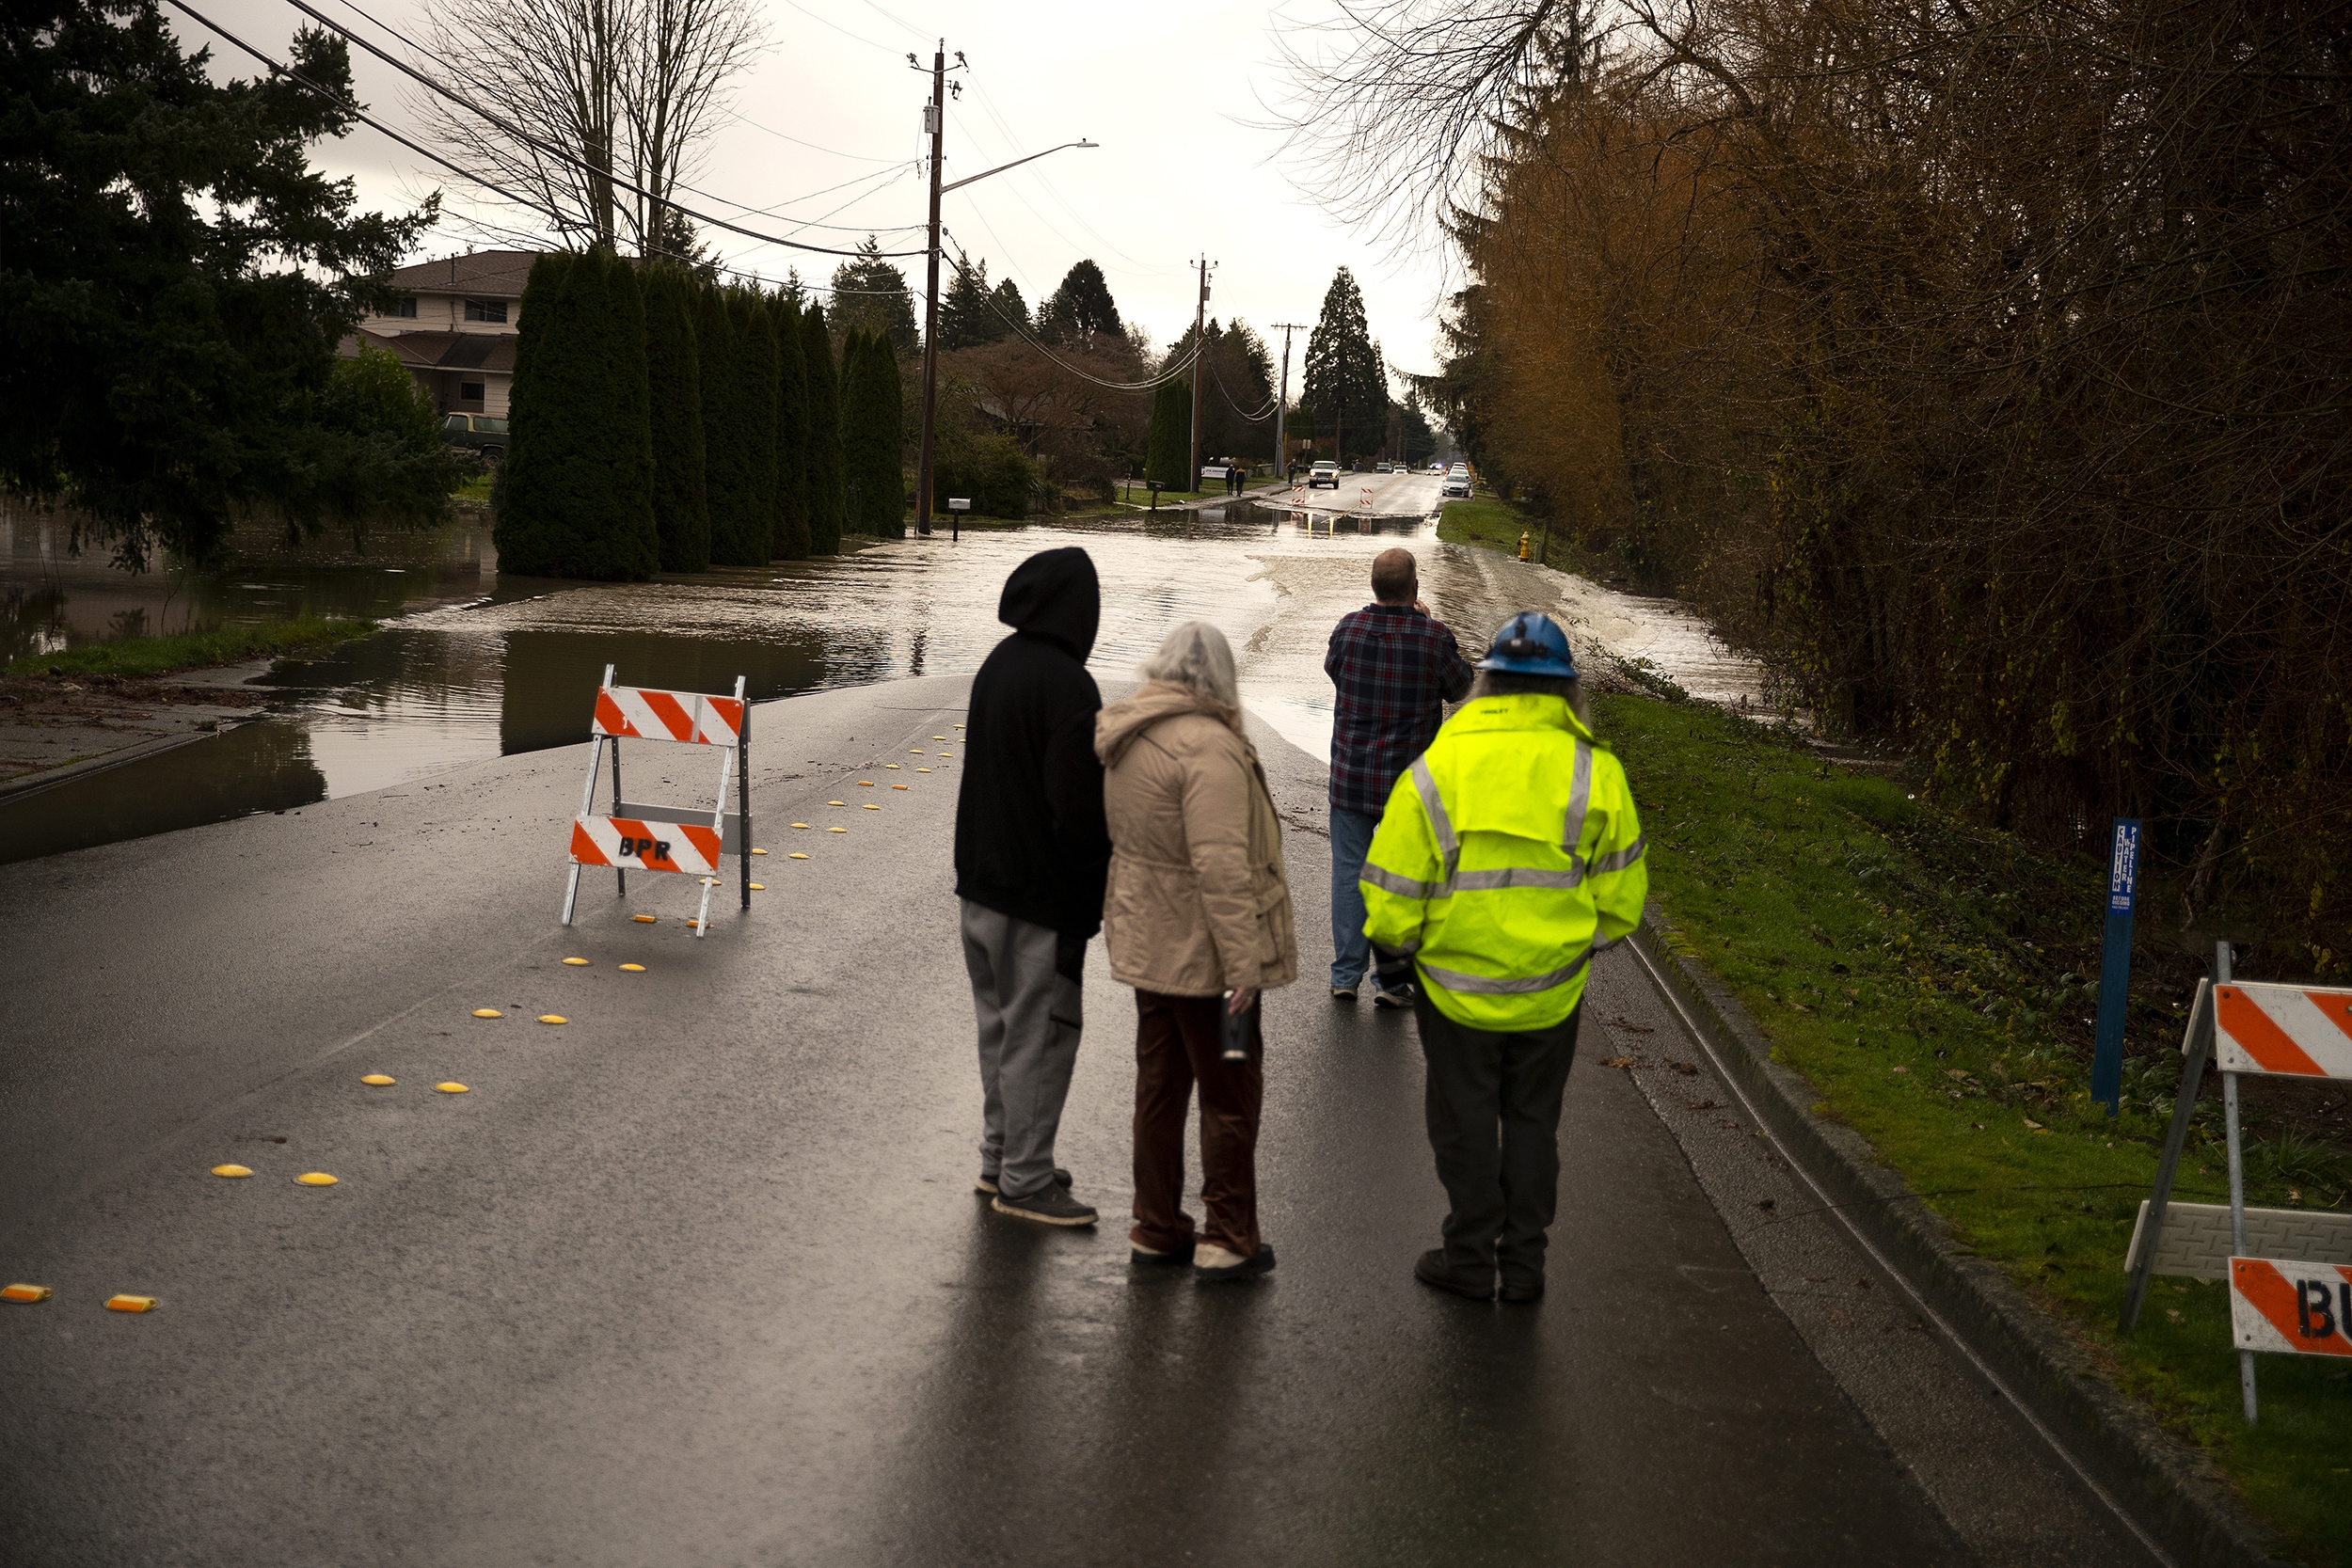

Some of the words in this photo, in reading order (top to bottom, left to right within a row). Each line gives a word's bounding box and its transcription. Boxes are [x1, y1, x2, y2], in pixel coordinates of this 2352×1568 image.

[619, 836, 671, 861] BPR
[2113, 828, 2123, 890] CAUTION
[2122, 838, 2131, 881] WATER
[2126, 827, 2137, 893] PIPELINE
